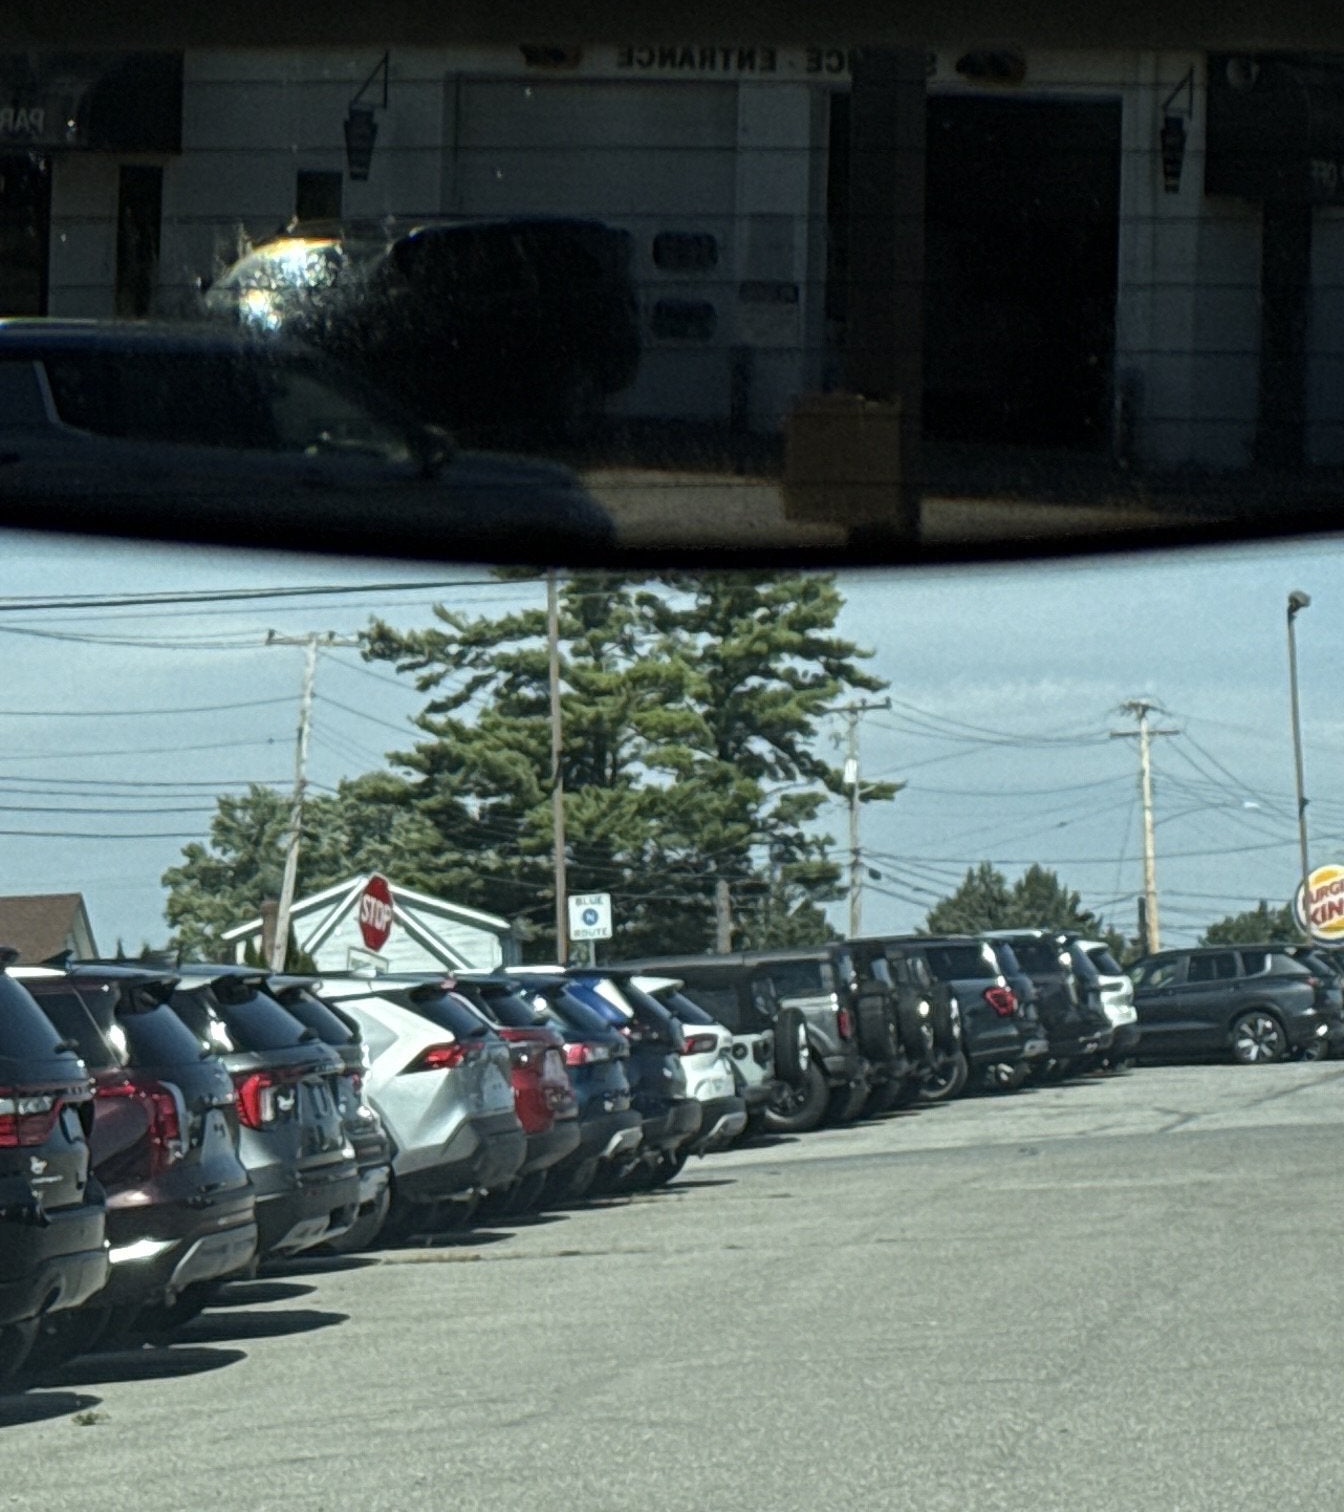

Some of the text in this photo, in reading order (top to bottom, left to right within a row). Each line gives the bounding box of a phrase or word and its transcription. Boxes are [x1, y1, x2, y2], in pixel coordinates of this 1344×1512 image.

[575, 896, 604, 906] BLUE
[361, 893, 391, 932] STOP
[574, 928, 607, 937] ROUTE
